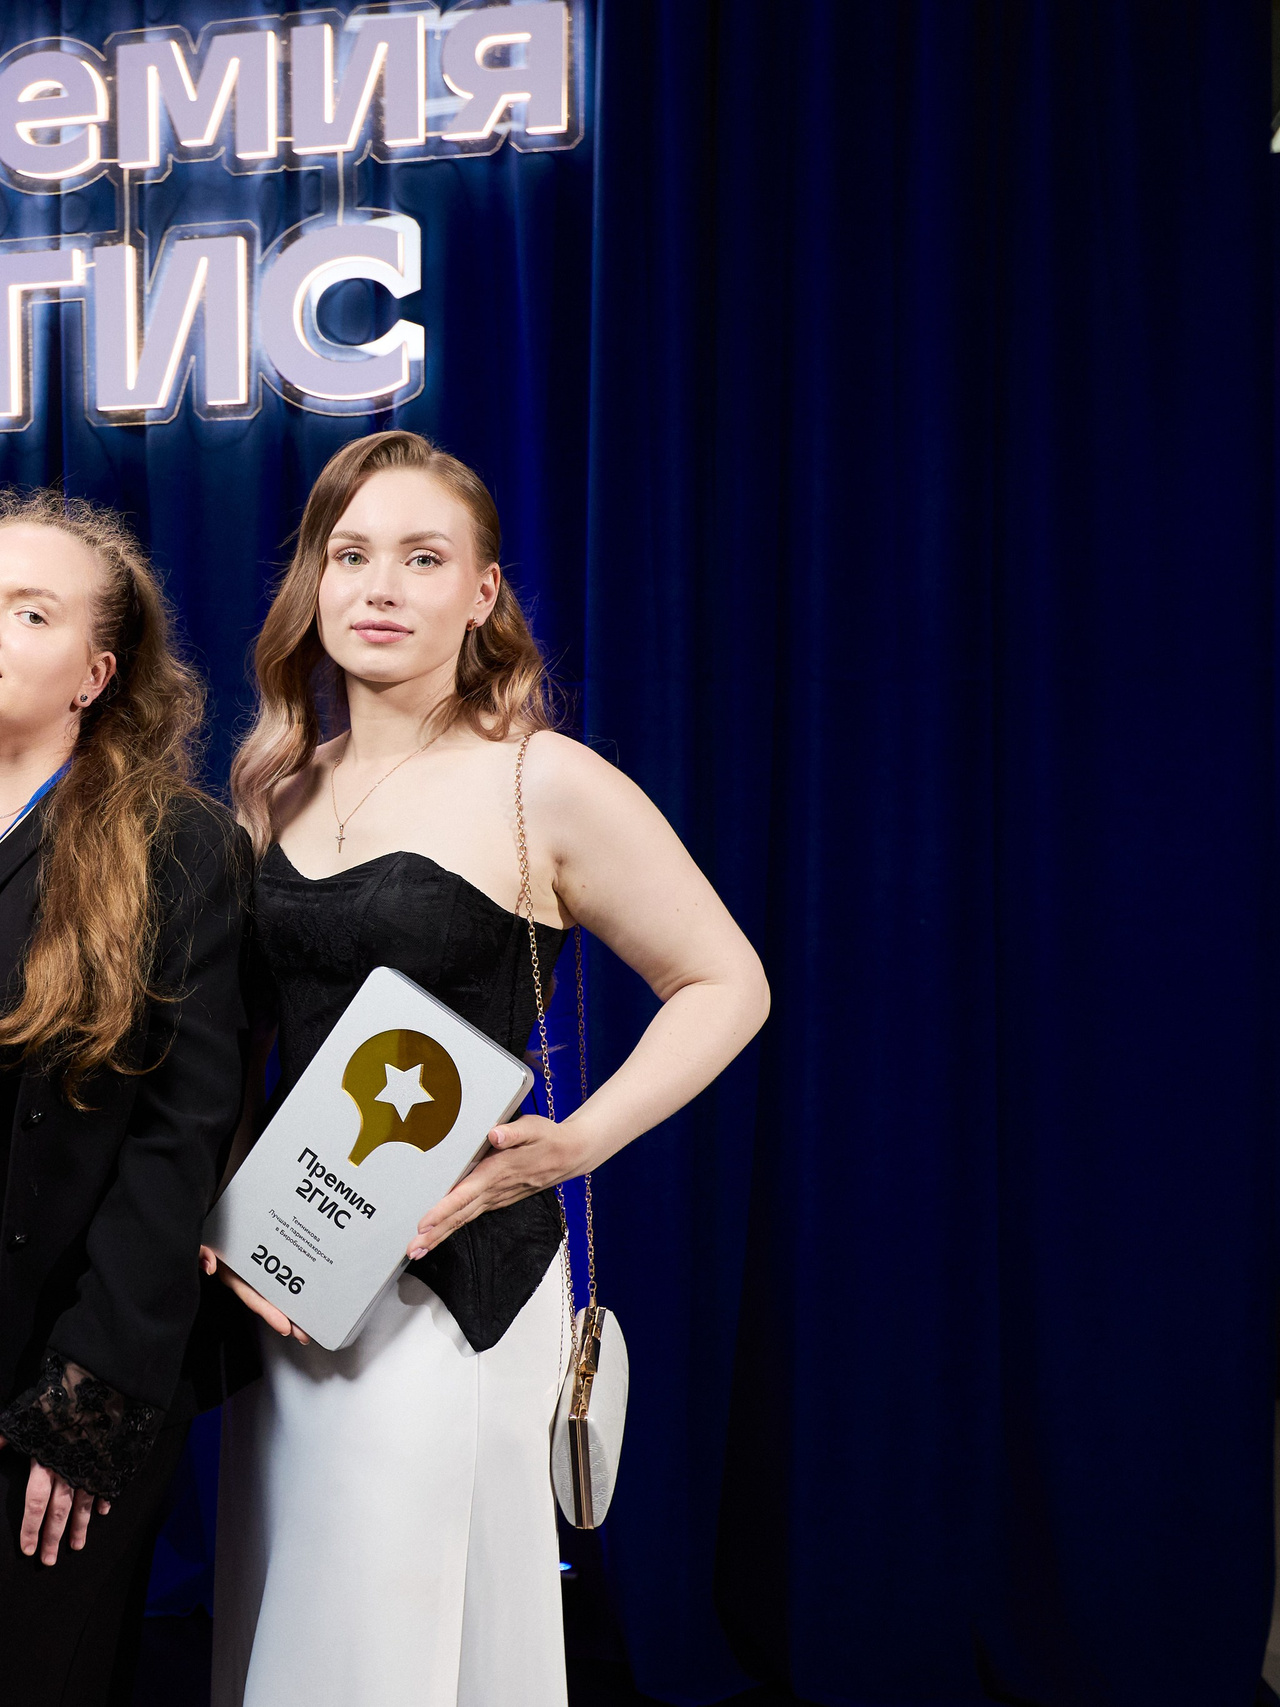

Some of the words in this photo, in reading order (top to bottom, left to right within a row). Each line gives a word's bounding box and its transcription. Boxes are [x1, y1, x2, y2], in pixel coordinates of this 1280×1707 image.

[295, 1178, 352, 1230] 2ГИС
[296, 1147, 377, 1220] Премия
[268, 1208, 290, 1229] Лучшая
[289, 1226, 334, 1265] парикмахерская
[279, 1229, 317, 1263] Биробиджане
[291, 1215, 321, 1243] Темникова
[250, 1244, 306, 1296] 2026
